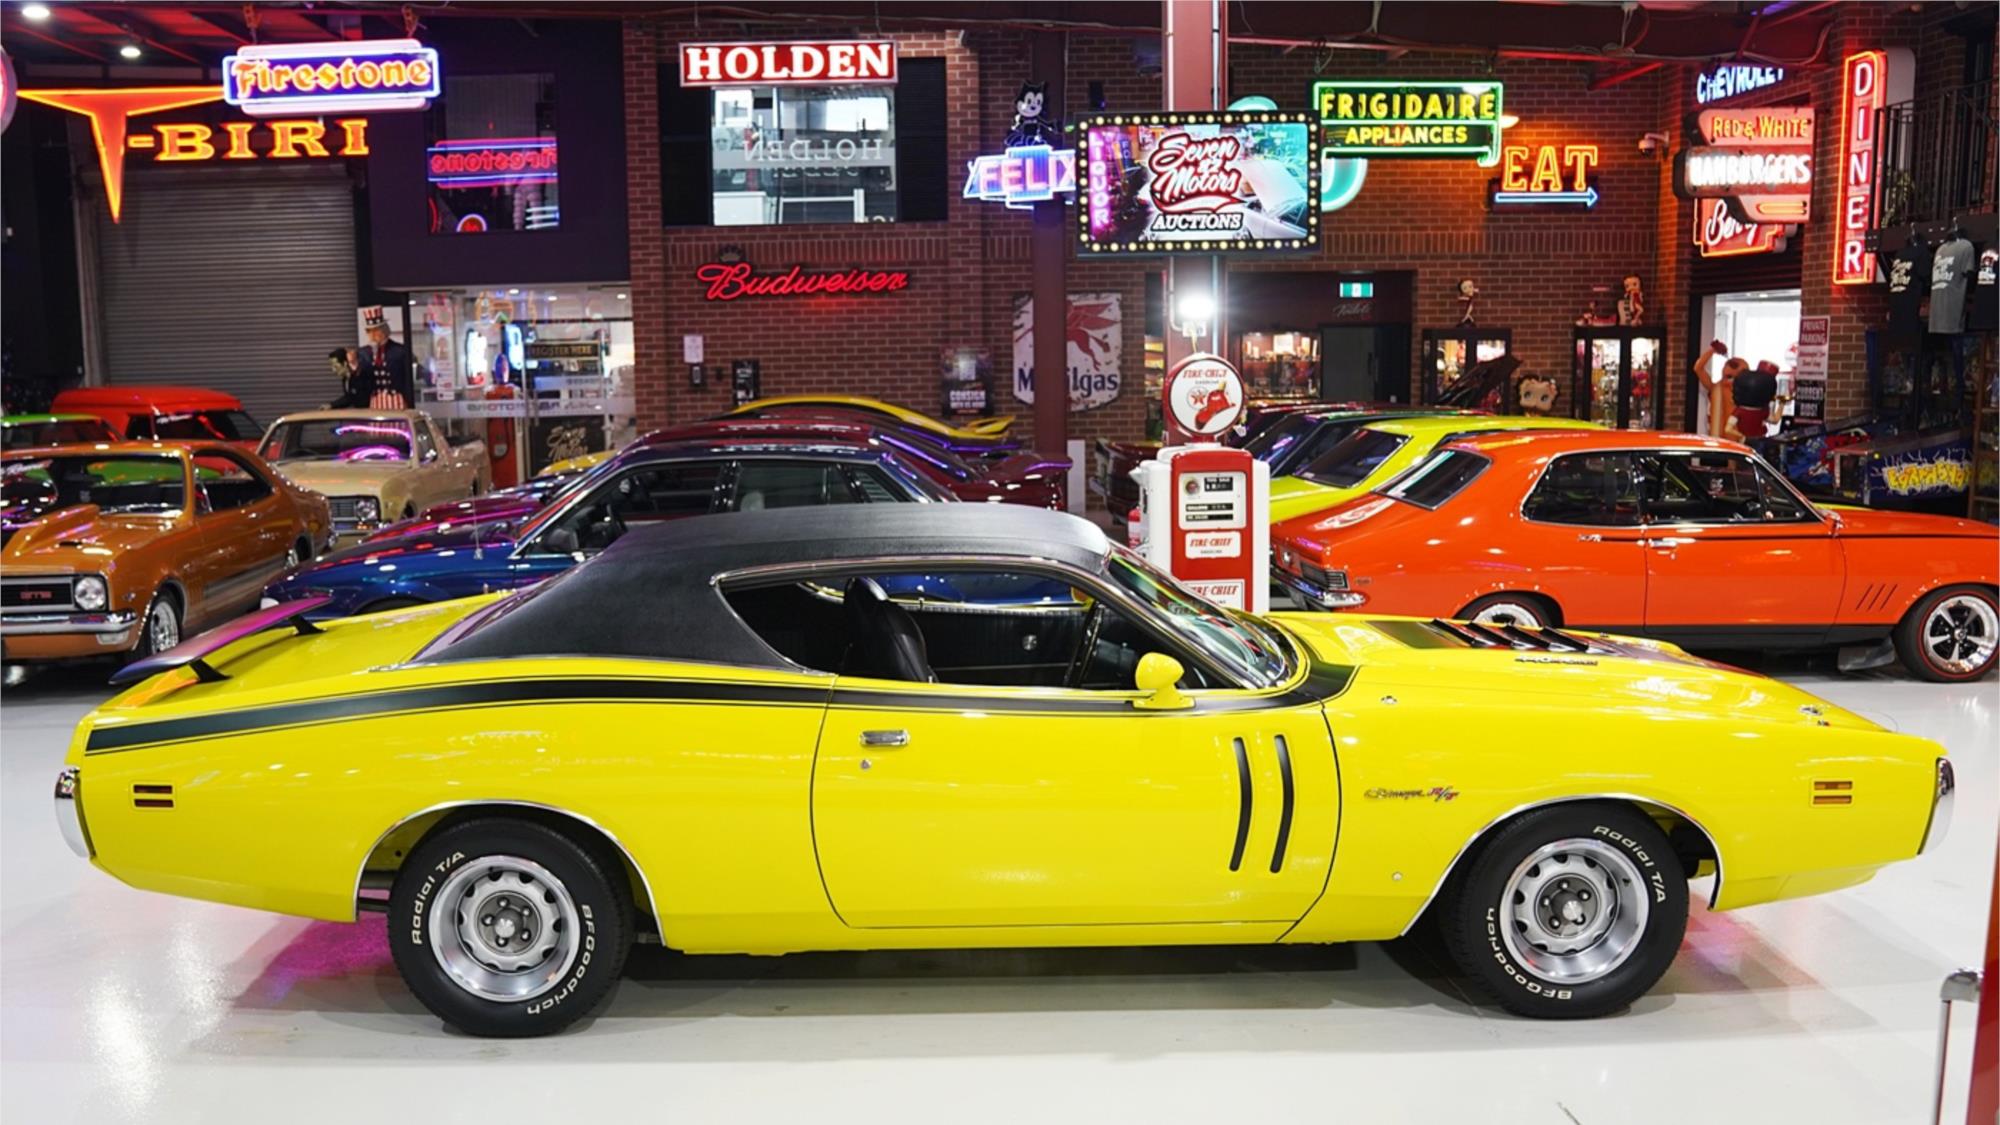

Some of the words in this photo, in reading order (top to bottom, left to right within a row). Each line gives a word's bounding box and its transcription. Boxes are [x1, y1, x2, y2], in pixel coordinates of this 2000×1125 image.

[232, 59, 430, 98] Firestone
[686, 44, 890, 80] HOLDEN
[1321, 93, 1496, 119] FRIGIDAIRE
[1345, 126, 1468, 144] APPLIANCES
[1713, 116, 1743, 138] RED
[1744, 121, 1755, 138] &
[1759, 114, 1808, 138] WHITE
[1151, 133, 1237, 172] Seven
[1502, 145, 1598, 192] EAT
[1688, 153, 1812, 186] HAMBURGERS
[1844, 63, 1873, 273] DINER
[977, 154, 1076, 193] FELIX
[1088, 131, 1109, 228] LIQUOR
[1151, 168, 1240, 203] Motors
[1151, 213, 1242, 230] AUCTIONS
[697, 263, 908, 299] Budweiser
[1018, 367, 1118, 398] Mlgas
[1593, 825, 1655, 868] Radial
[1650, 871, 1667, 903] T/A
[411, 875, 436, 945] Radial
[435, 851, 465, 873] T/A
[527, 904, 596, 1016] BFGoodrich
[1485, 907, 1573, 1000] BFGoodrich
